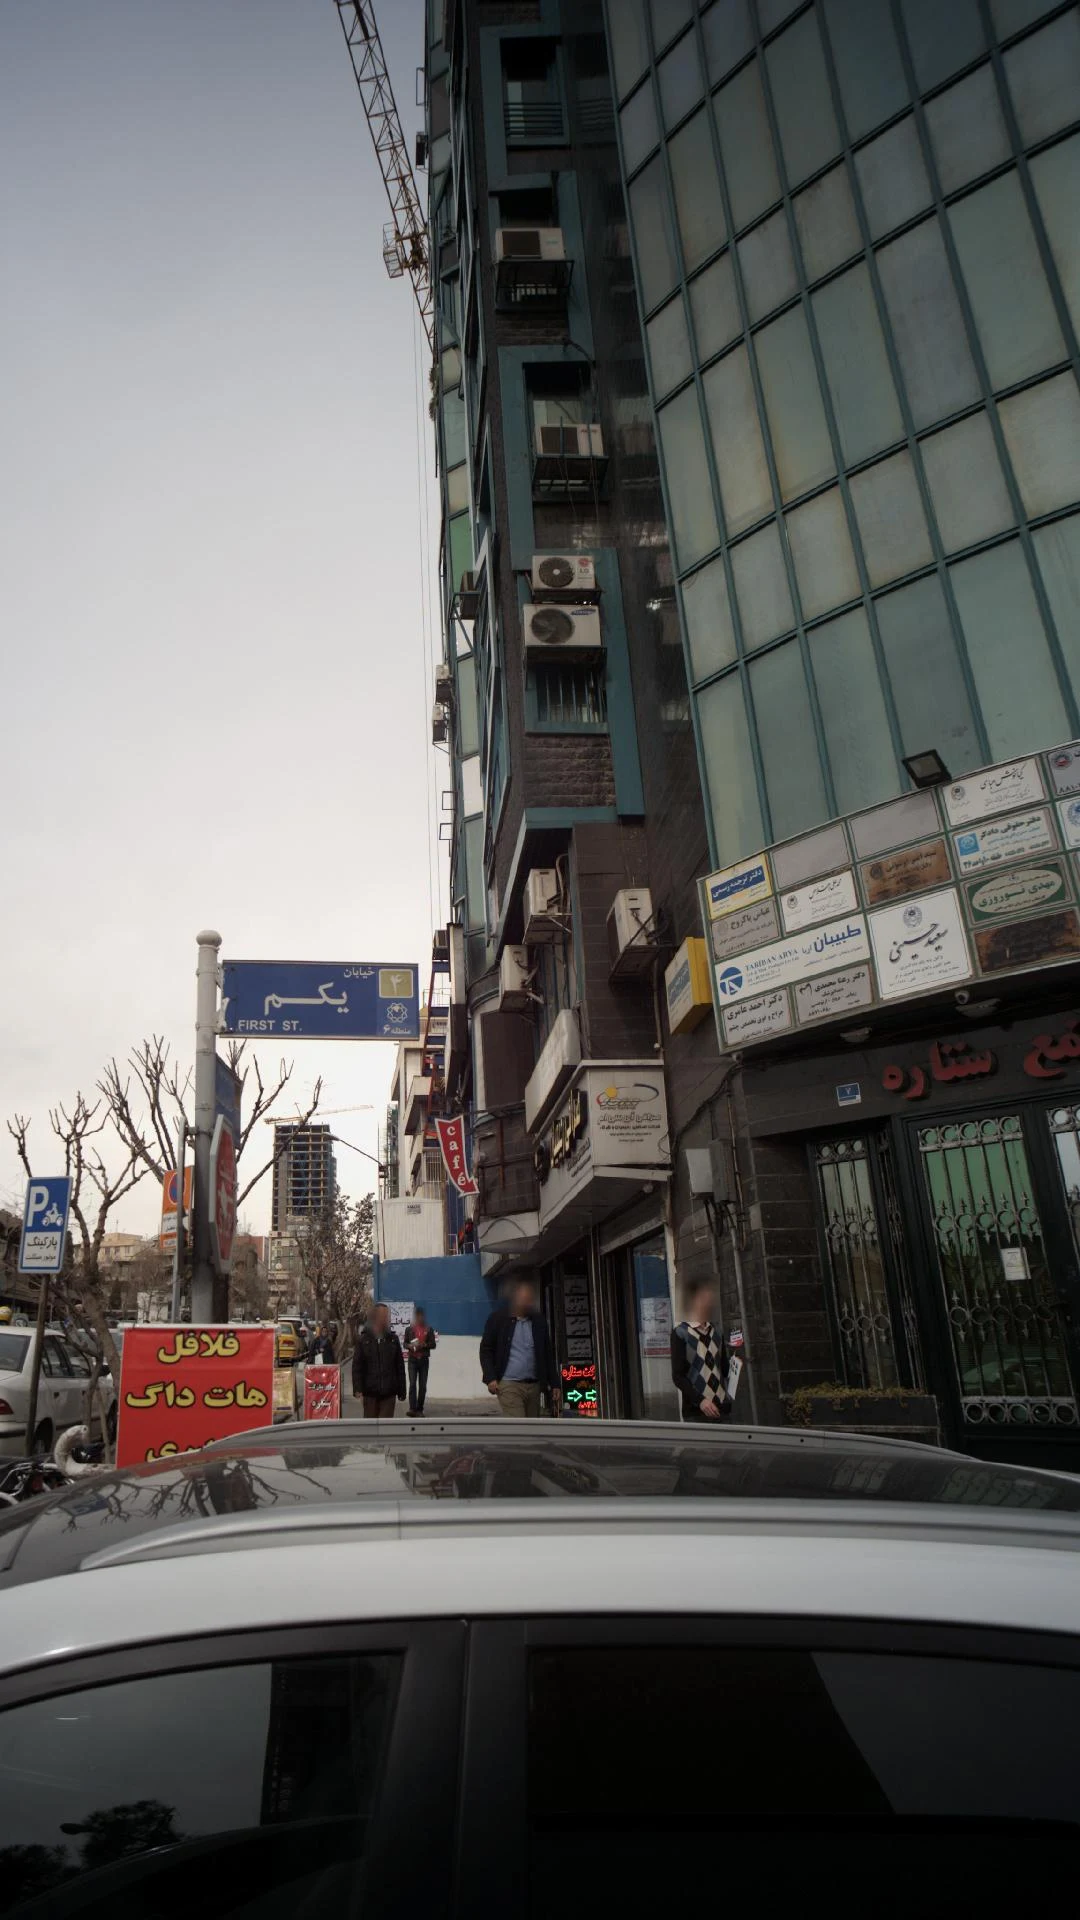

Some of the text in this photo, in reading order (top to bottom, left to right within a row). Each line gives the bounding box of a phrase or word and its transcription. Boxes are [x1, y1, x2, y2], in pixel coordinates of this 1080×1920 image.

[1026, 816, 1041, 828] دفتر
[1028, 880, 1056, 894] مهدی
[814, 925, 862, 953] طبیبان
[889, 923, 939, 963] حسینی
[343, 967, 375, 979] خیابان
[390, 974, 403, 995] ۴
[852, 972, 866, 983] دکتر
[264, 982, 350, 1016] یکم
[814, 981, 837, 992] محمدی
[727, 994, 783, 1020] دکتر احمد عامری
[238, 1020, 303, 1032] FIRST ST.
[882, 1041, 995, 1101] ستاره
[446, 1126, 466, 1186] café
[27, 1185, 49, 1227] P
[27, 1236, 58, 1251] پارکینگ
[157, 1330, 240, 1364] فلافل
[125, 1381, 268, 1408] هات داگ
